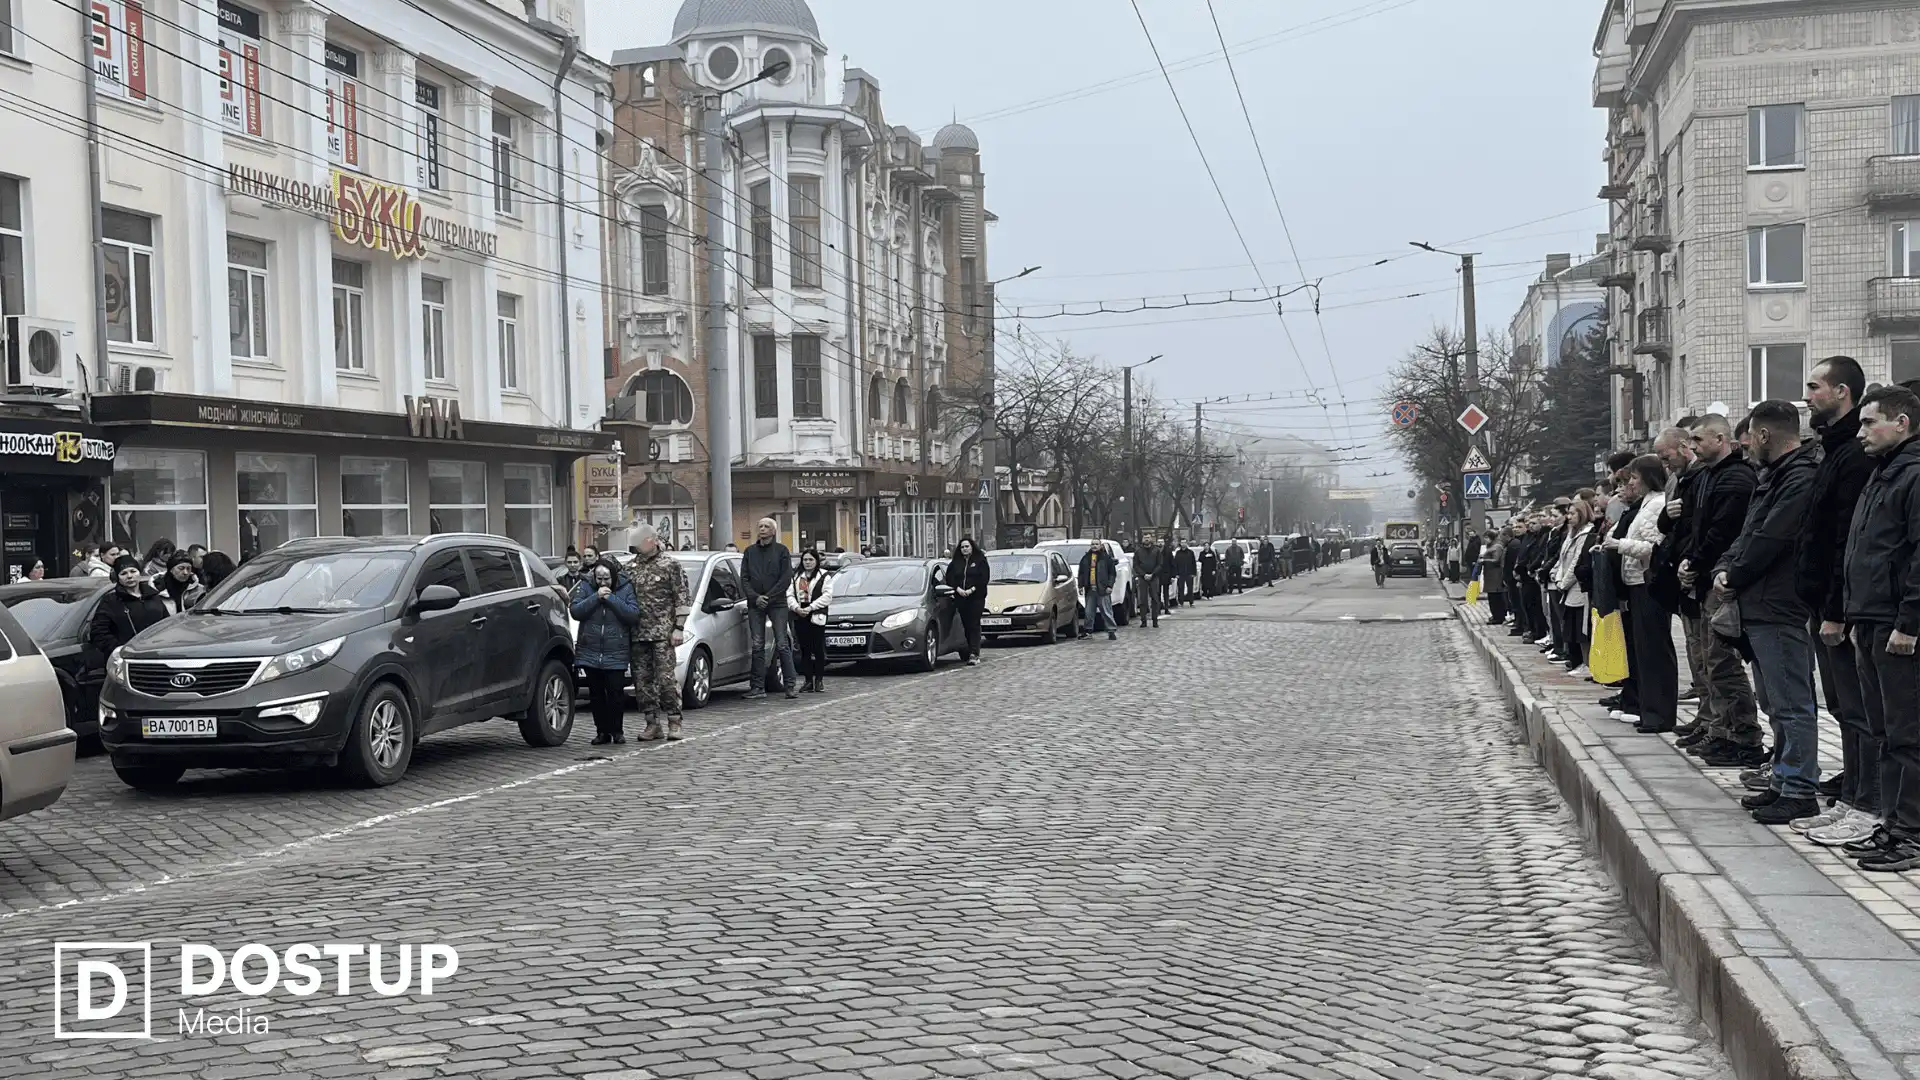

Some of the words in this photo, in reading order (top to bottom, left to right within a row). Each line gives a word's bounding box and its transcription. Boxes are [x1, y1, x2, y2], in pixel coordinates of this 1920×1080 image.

[130, 22, 139, 77] КОЛЕДЖІ
[325, 49, 347, 68] ОЛЬЩІ
[229, 161, 334, 216] КНИЖКОВИЙ
[335, 172, 427, 257] БУКИ
[423, 215, 498, 256] СУПЕРМАРКЕТ
[198, 404, 238, 423] МОДНИЙ
[240, 407, 280, 425] ЖІНОЧИЙ
[0, 433, 56, 455] HOOKAH
[174, 676, 191, 684] KIA
[149, 720, 166, 732] BA
[168, 720, 194, 732] 7001
[197, 719, 215, 732] BA
